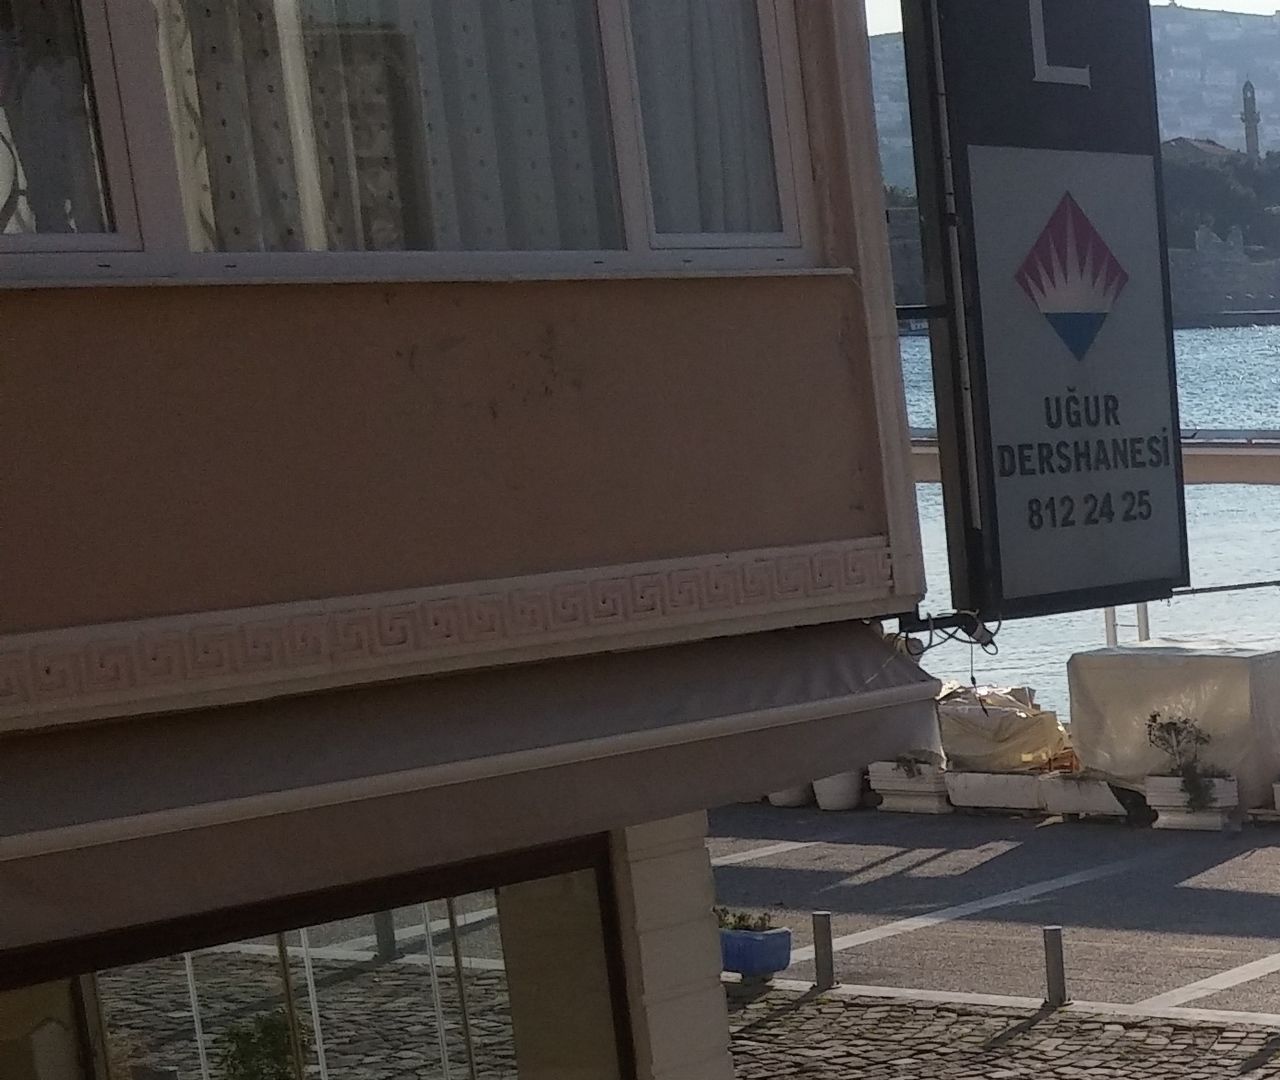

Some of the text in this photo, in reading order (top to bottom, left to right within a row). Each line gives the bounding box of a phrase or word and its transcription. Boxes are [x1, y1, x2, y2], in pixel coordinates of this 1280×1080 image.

[1044, 386, 1121, 429] UĞUR
[997, 427, 1171, 478] DERSHANESİ
[1027, 490, 1153, 530] 812 24 25
